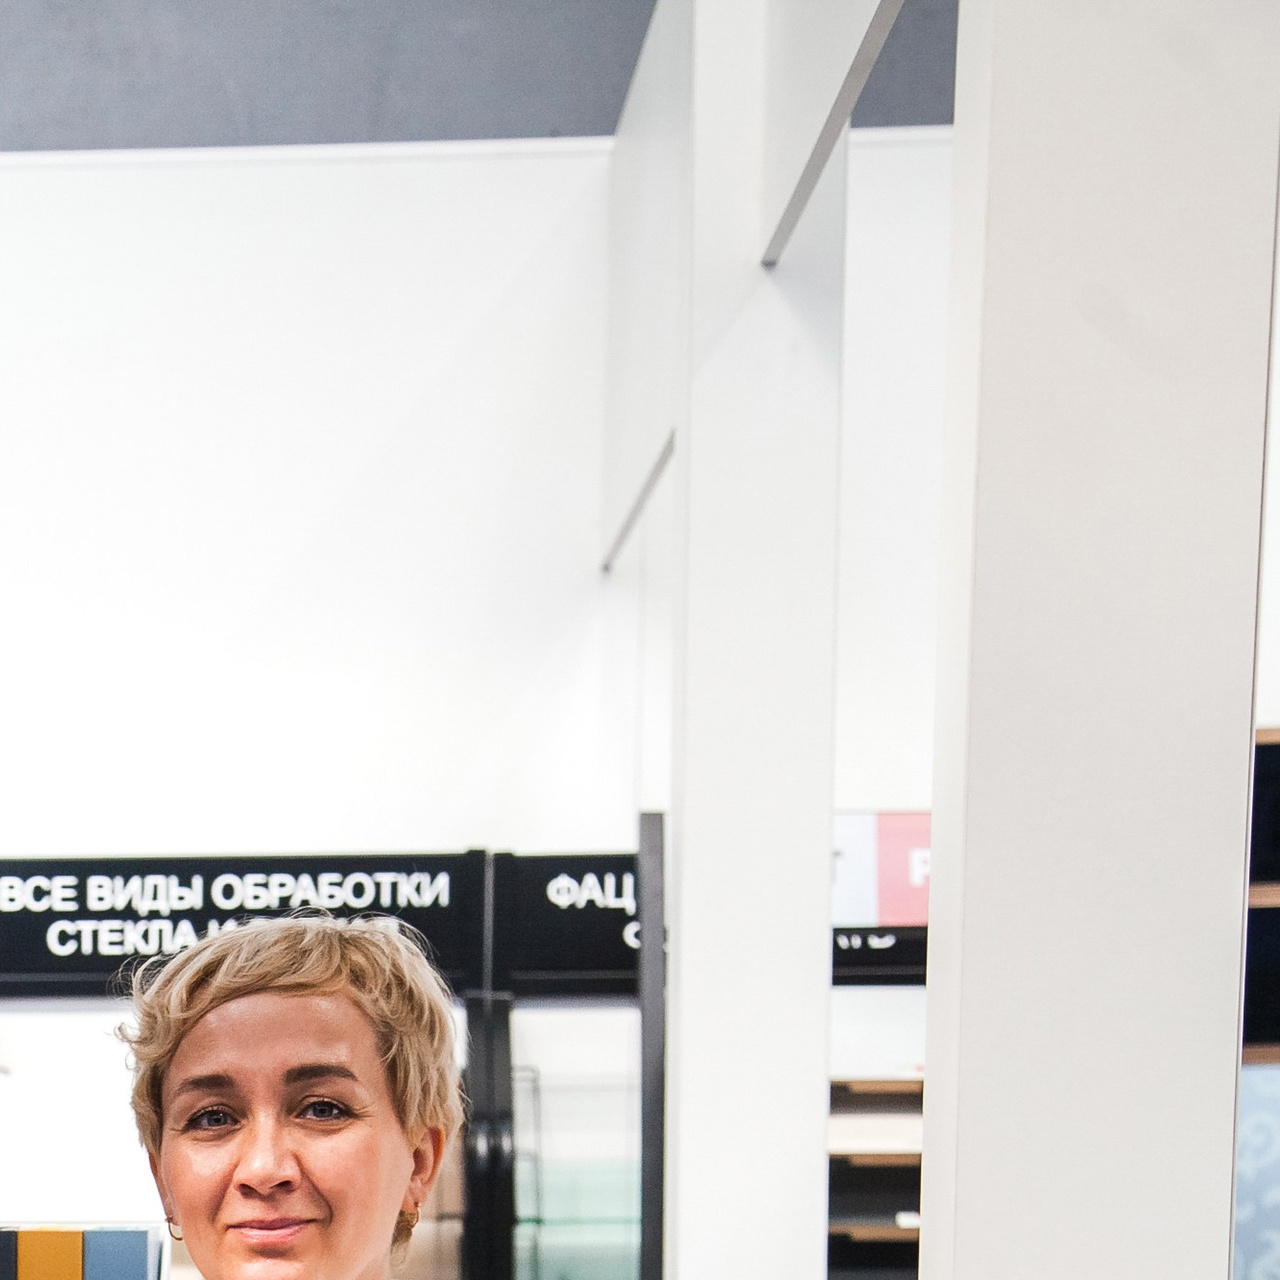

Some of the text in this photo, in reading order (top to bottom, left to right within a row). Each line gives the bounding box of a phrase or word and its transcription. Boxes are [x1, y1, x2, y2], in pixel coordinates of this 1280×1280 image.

[86, 874, 204, 917] ВИДЫ
[210, 872, 451, 910] ОБРАБОТКИ
[45, 919, 198, 957] СТЕКЛА
